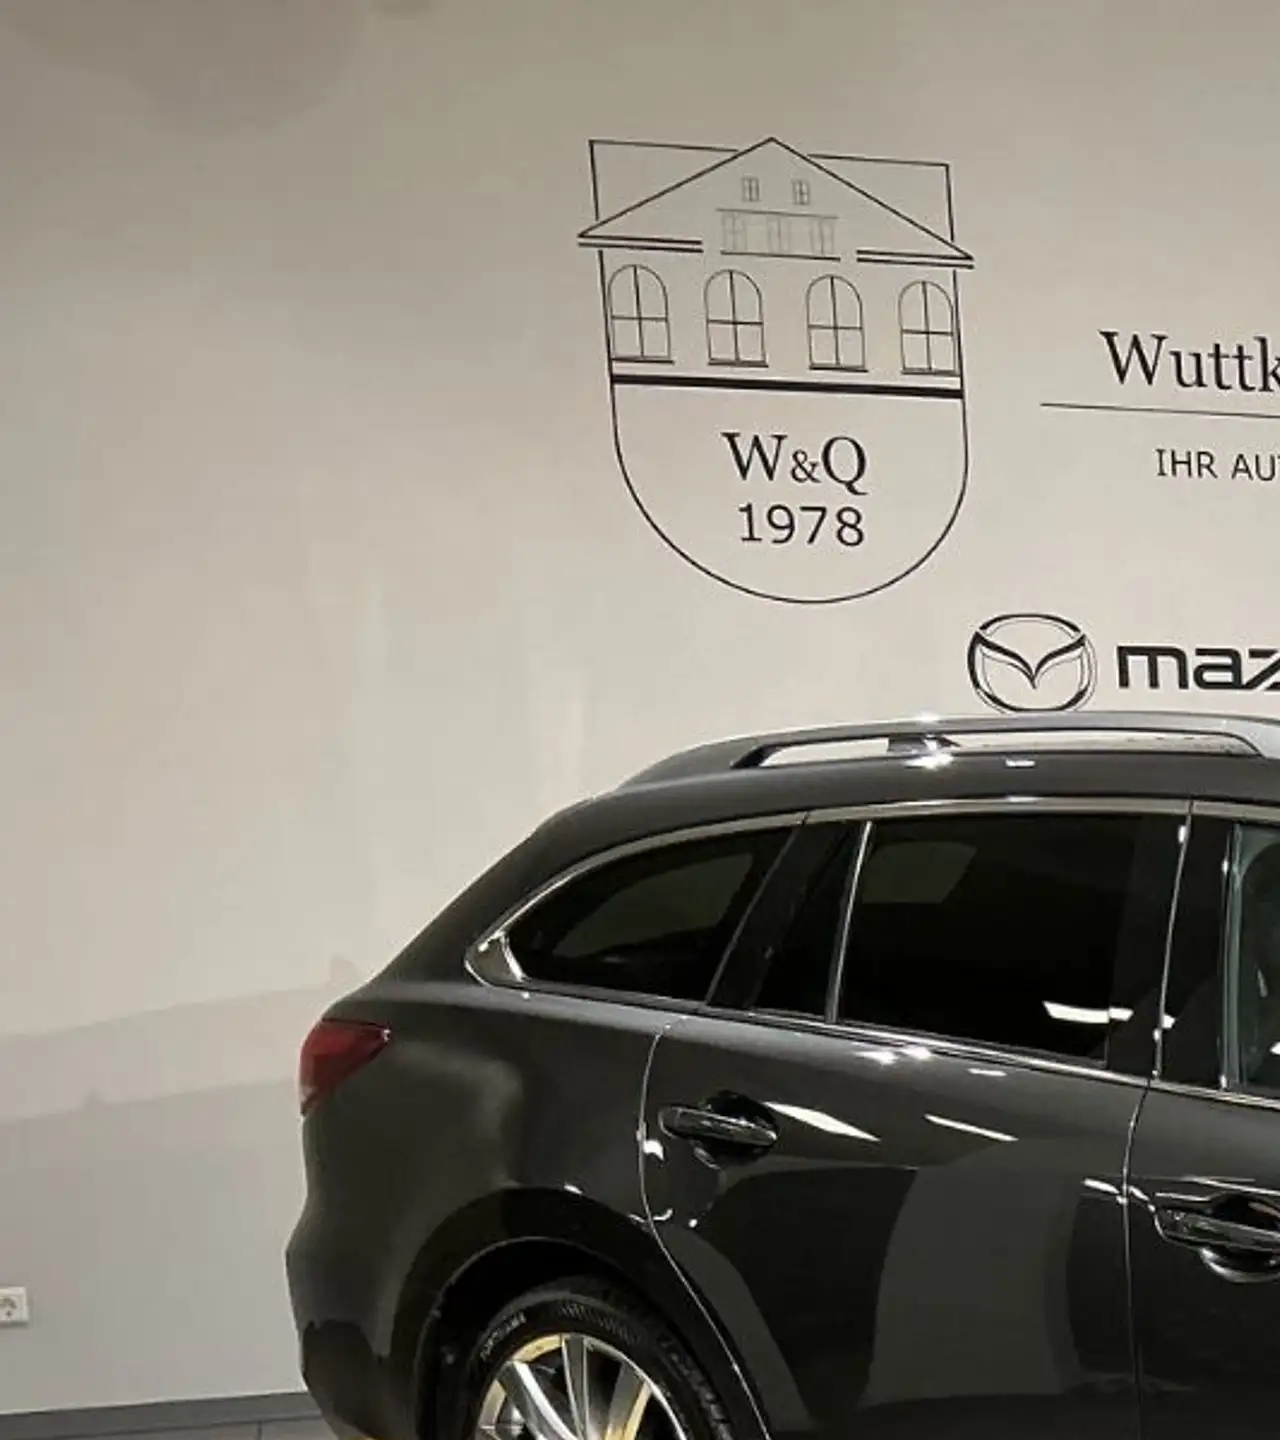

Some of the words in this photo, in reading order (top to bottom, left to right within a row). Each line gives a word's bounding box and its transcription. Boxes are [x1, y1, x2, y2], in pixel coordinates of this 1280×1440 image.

[720, 431, 869, 496] W&Q
[1155, 448, 1219, 479] IHR
[737, 502, 865, 548] 1978
